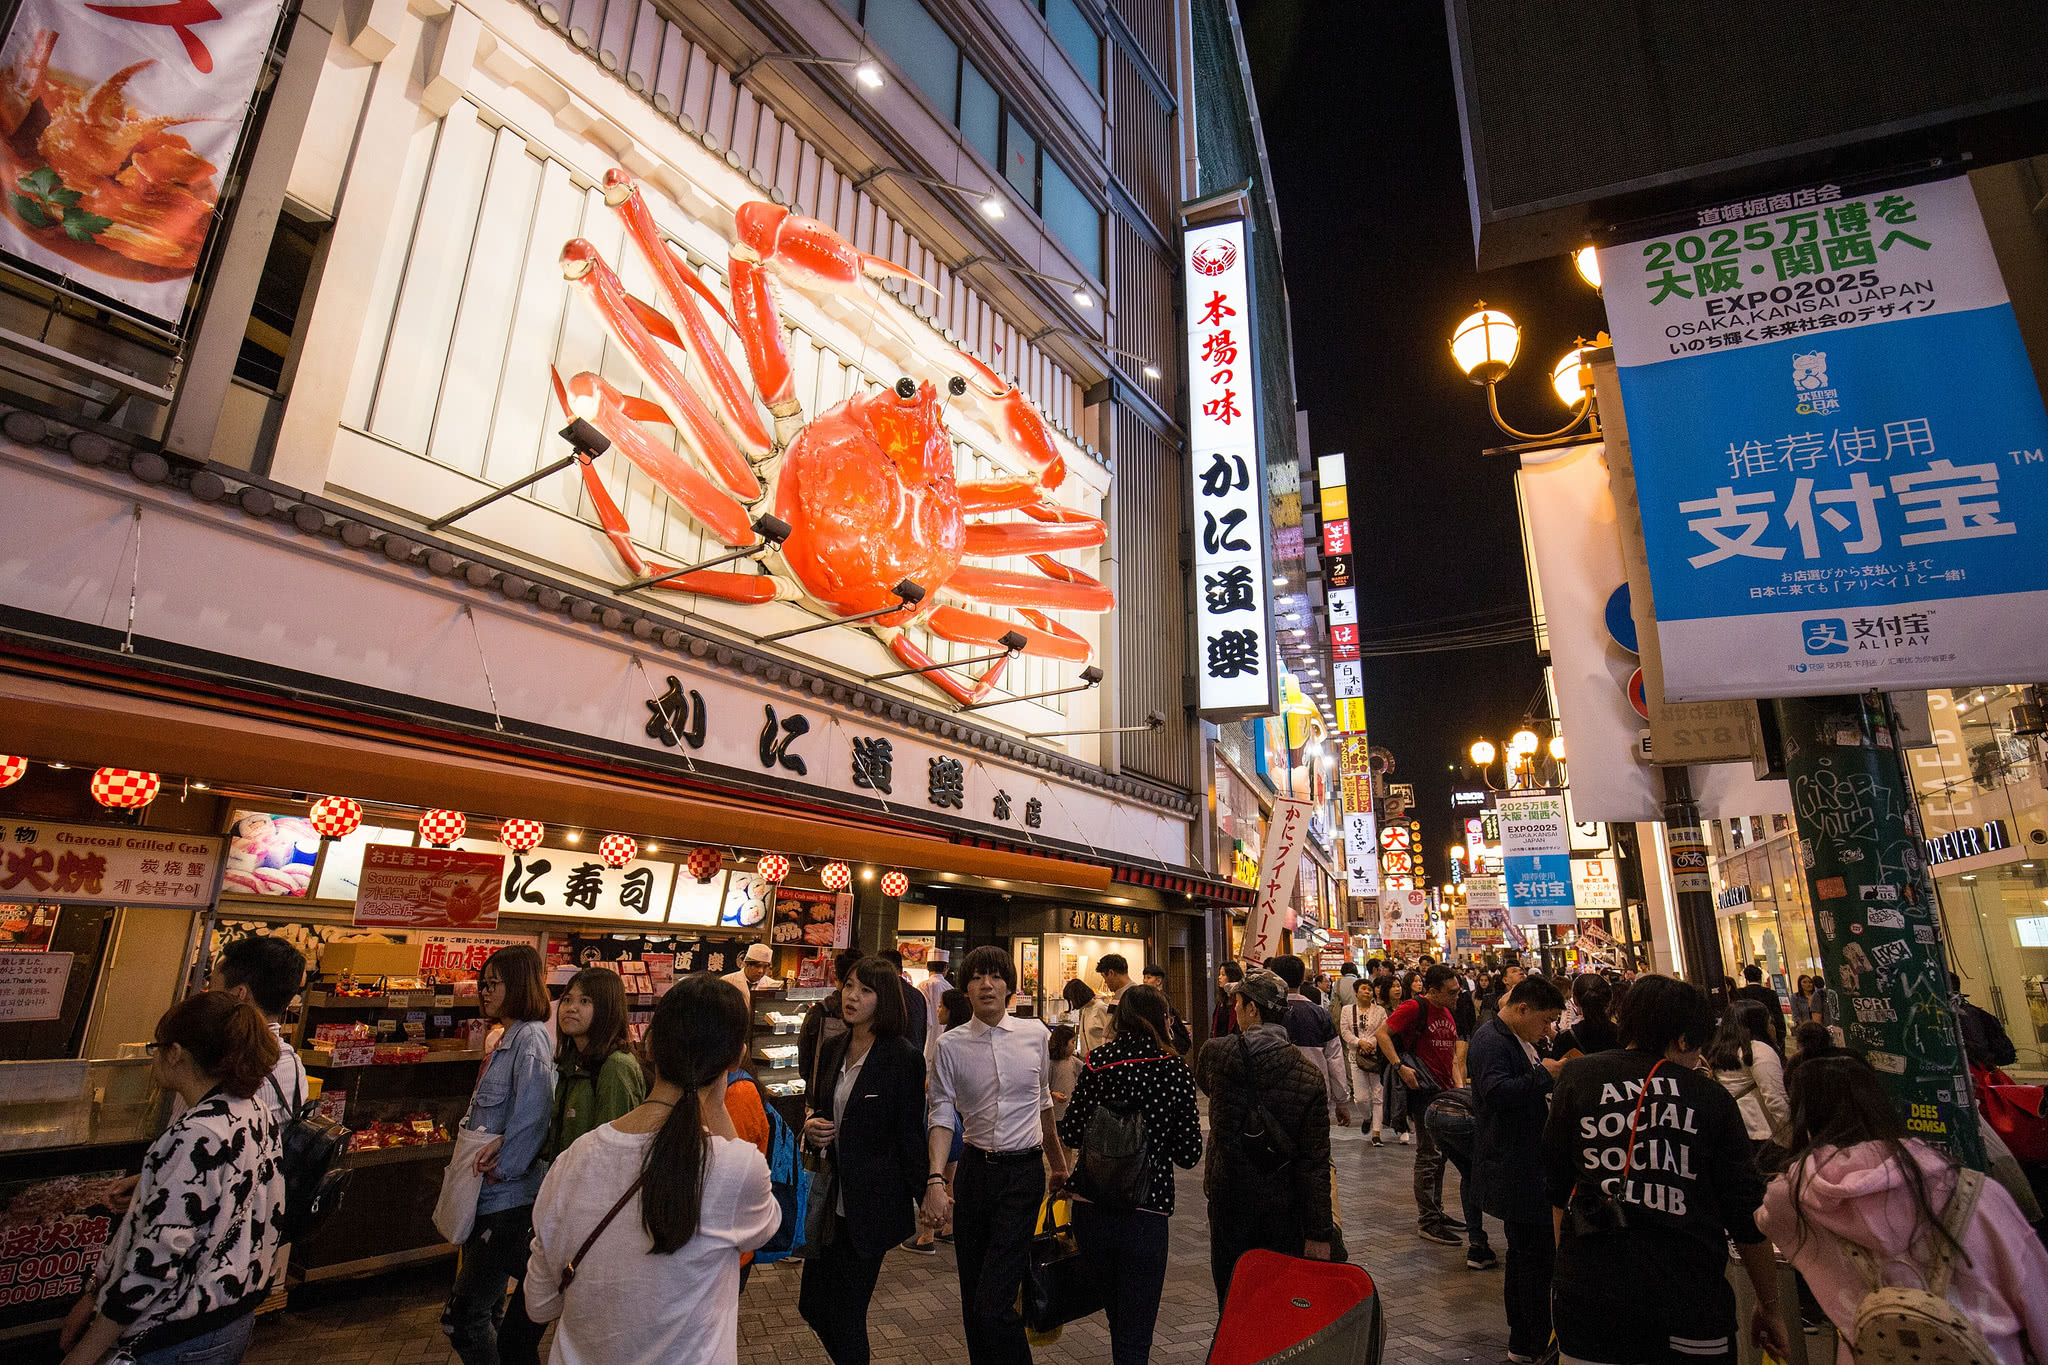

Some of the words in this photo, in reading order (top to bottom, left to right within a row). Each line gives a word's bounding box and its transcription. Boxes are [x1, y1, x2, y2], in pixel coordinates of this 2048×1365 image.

[1697, 183, 1843, 227] 道頓堀商店会
[1642, 195, 1917, 272] 2025万博を
[1646, 229, 1932, 306] 大阪・関西へ
[1706, 268, 1880, 317] EXPO2025
[1664, 295, 1841, 339] OSAKA,KANSAI
[1848, 279, 1934, 306] JAPAN
[1669, 298, 1936, 355] いのち輝く未来社会のデザイン
[1197, 290, 1242, 426] 本場の味
[1812, 399, 1840, 411] 日本
[1725, 417, 1936, 479] 推荐使用
[2008, 448, 2045, 466] TM
[1678, 458, 2018, 570] 支付宝
[1780, 558, 1934, 584] お店選びから支払いまで
[1851, 613, 1931, 640] 支付宝
[1858, 635, 1930, 650] ALIPAY
[1500, 800, 1559, 812] 2025万博を
[1501, 810, 1561, 822] 大阪・関西へ
[0, 825, 39, 844] 物
[1507, 824, 1558, 833] EXPO2025
[56, 831, 122, 849] Charcoal
[125, 838, 176, 853] Grilled
[178, 842, 209, 856] Crab
[1925, 827, 1982, 865] OREVER
[1984, 820, 2003, 851] 21
[0, 847, 107, 895] 火焼
[370, 850, 469, 869] お土産コーナー
[1348, 857, 1358, 865] 6F
[367, 871, 418, 888] Souvenir
[419, 876, 454, 889] corner
[456, 847, 655, 914] に寿司
[1253, 805, 1301, 951] かにブイヤベース
[1513, 880, 1567, 898] 支付宝
[1410, 894, 1422, 902] 2F
[1599, 1077, 1681, 1105] ANTI
[1580, 1102, 1699, 1140] SOCIAL
[1910, 1103, 1938, 1119] DEES
[1906, 1118, 1947, 1135] COMSA
[1584, 1139, 1698, 1181] SOCIAL
[1600, 1177, 1687, 1217] CLUB
